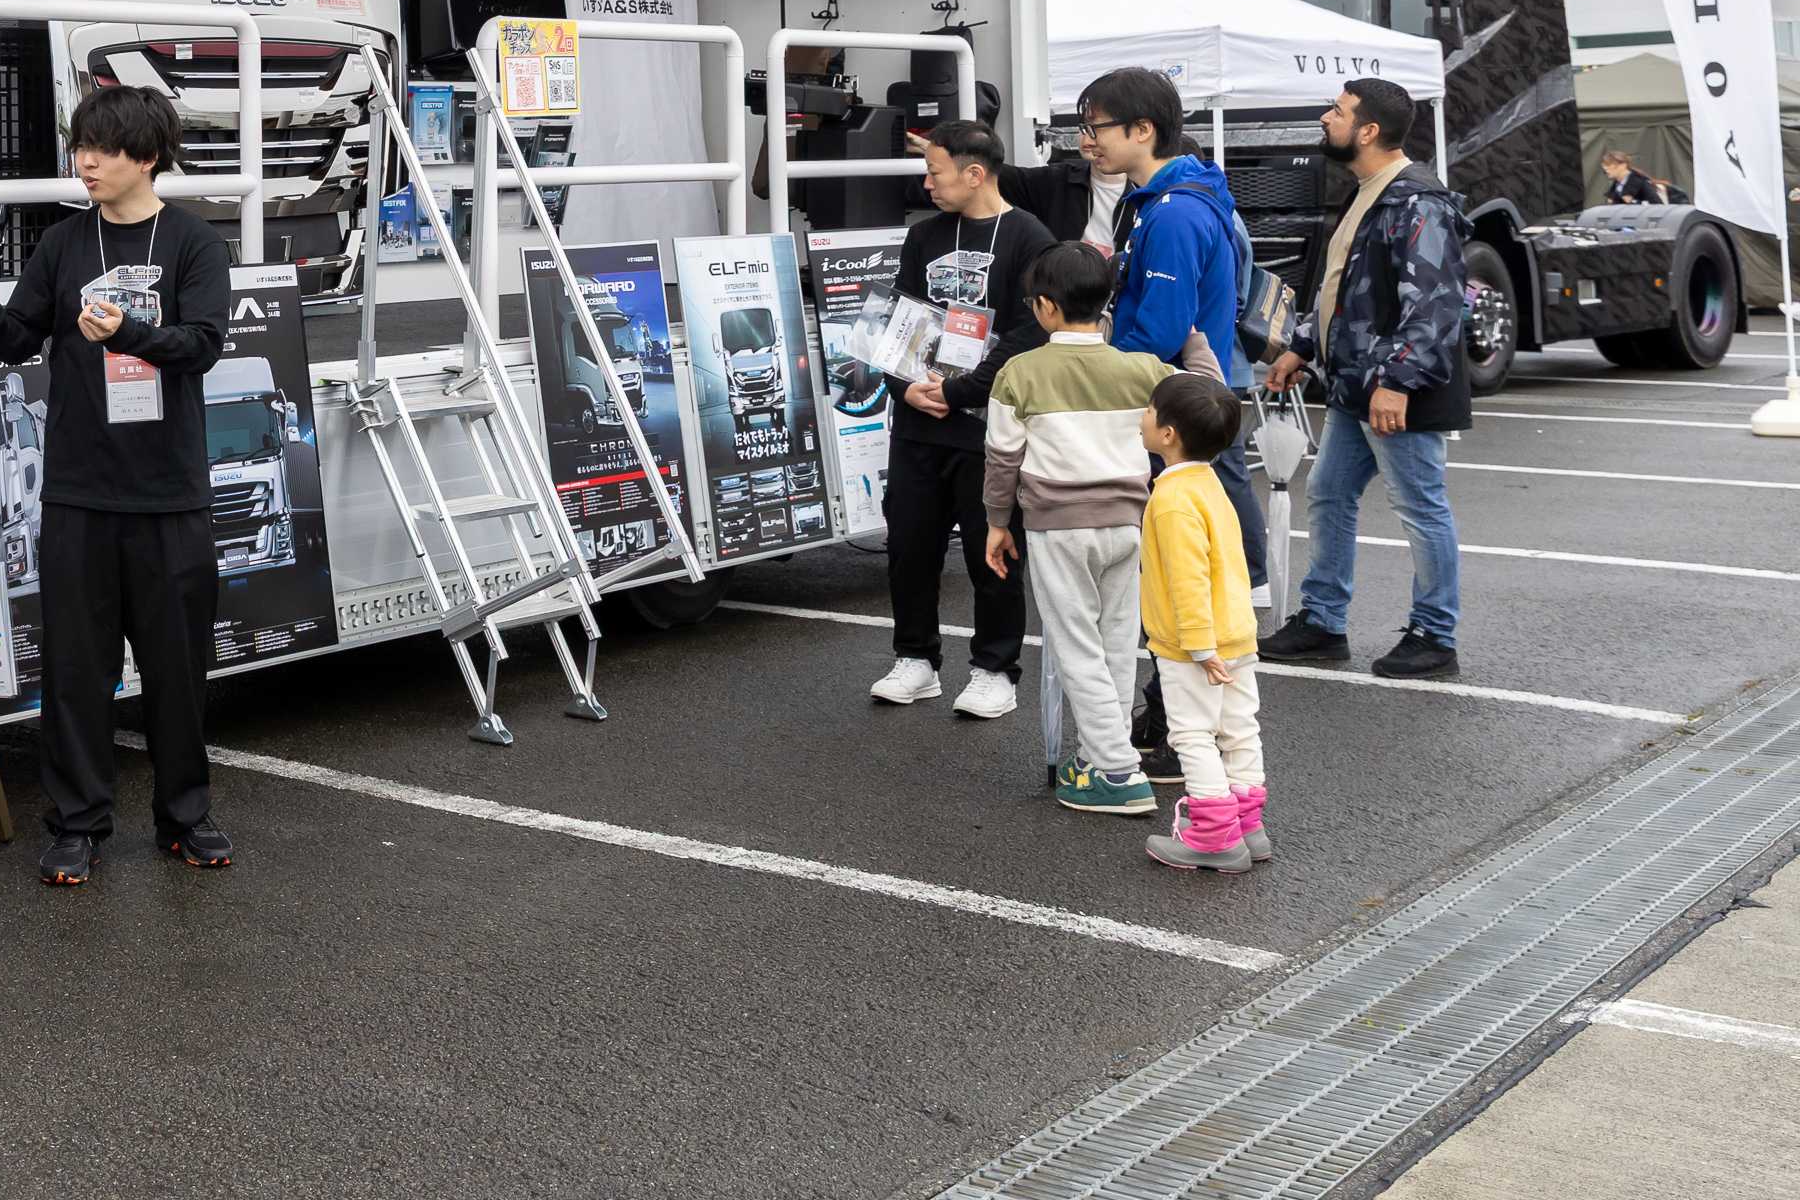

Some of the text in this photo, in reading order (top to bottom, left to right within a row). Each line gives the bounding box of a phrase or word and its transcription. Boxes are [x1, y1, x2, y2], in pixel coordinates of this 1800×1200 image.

[502, 22, 535, 41] ガラポン
[510, 40, 533, 55] チャンス
[549, 59, 562, 70] SNS
[1294, 55, 1380, 76] VOLVO
[1293, 157, 1310, 166] FH
[811, 237, 831, 247] ISUZU
[531, 260, 556, 270] ISUZU
[821, 257, 867, 272] i-Cool
[227, 553, 248, 563] GIGA
